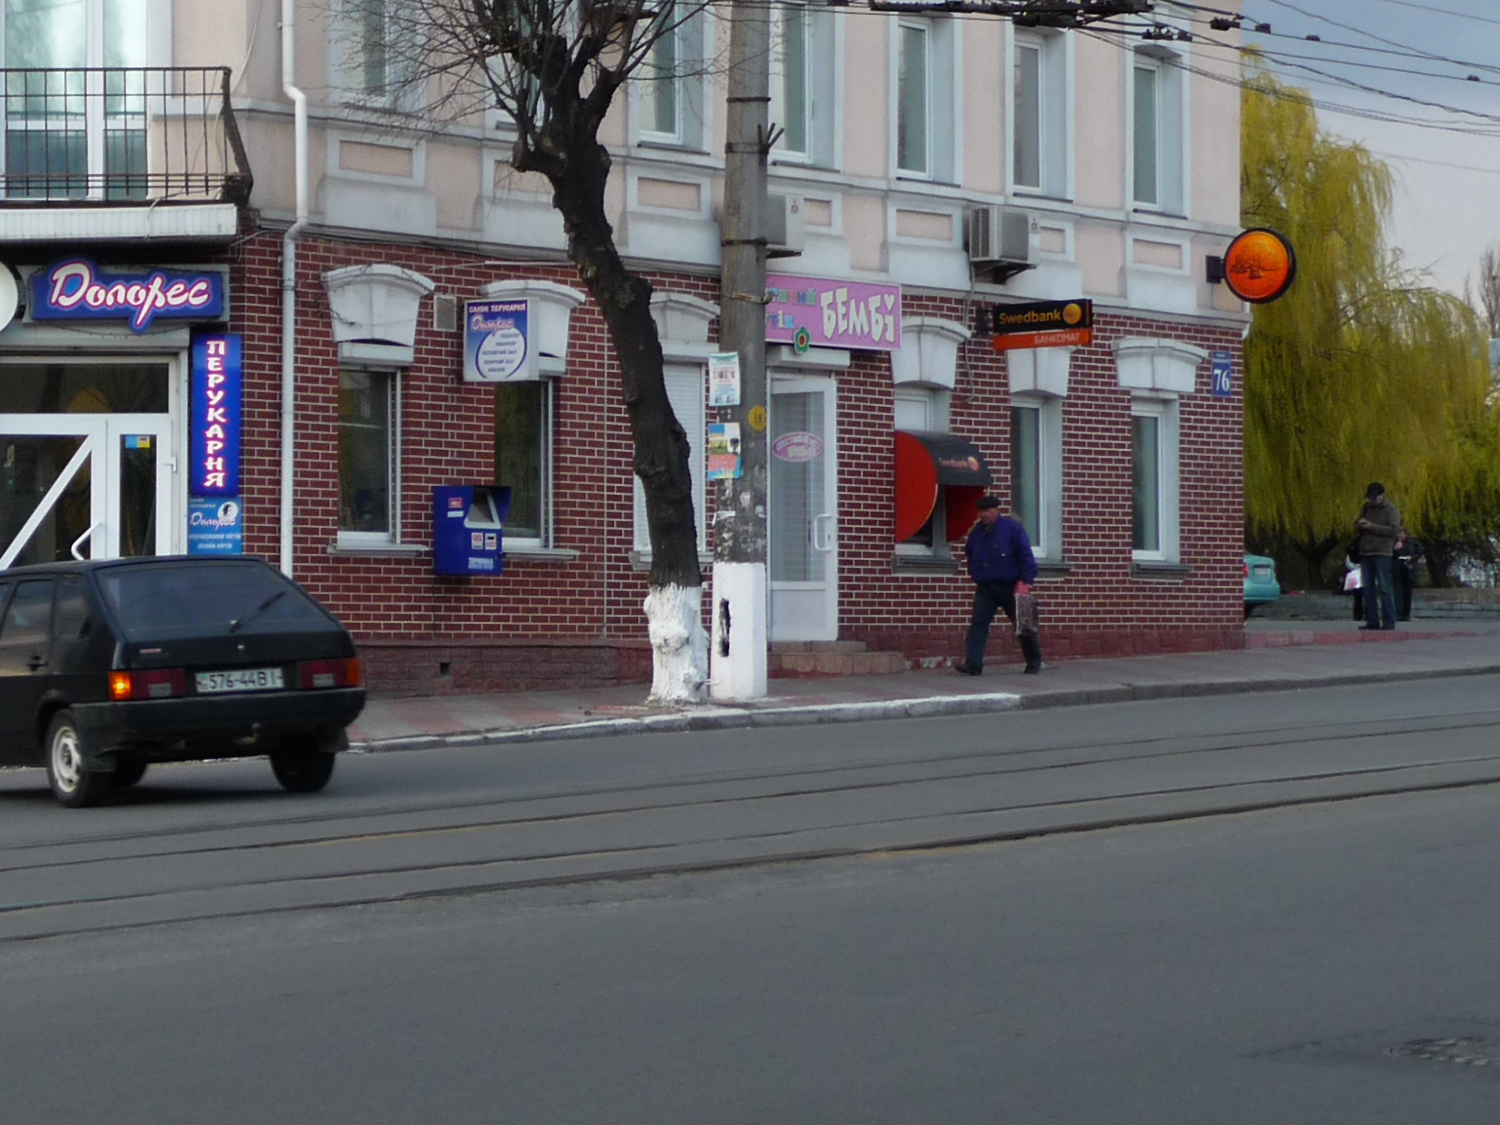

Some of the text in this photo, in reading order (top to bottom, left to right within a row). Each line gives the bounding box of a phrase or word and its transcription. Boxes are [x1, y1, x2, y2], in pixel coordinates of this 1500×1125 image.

[51, 262, 208, 326] Долорес
[999, 308, 1061, 325] Swedbank
[1034, 332, 1080, 345] БАНКОМАТ
[1213, 368, 1230, 392] 76
[203, 340, 228, 488] ПЕРУКАРНЯ
